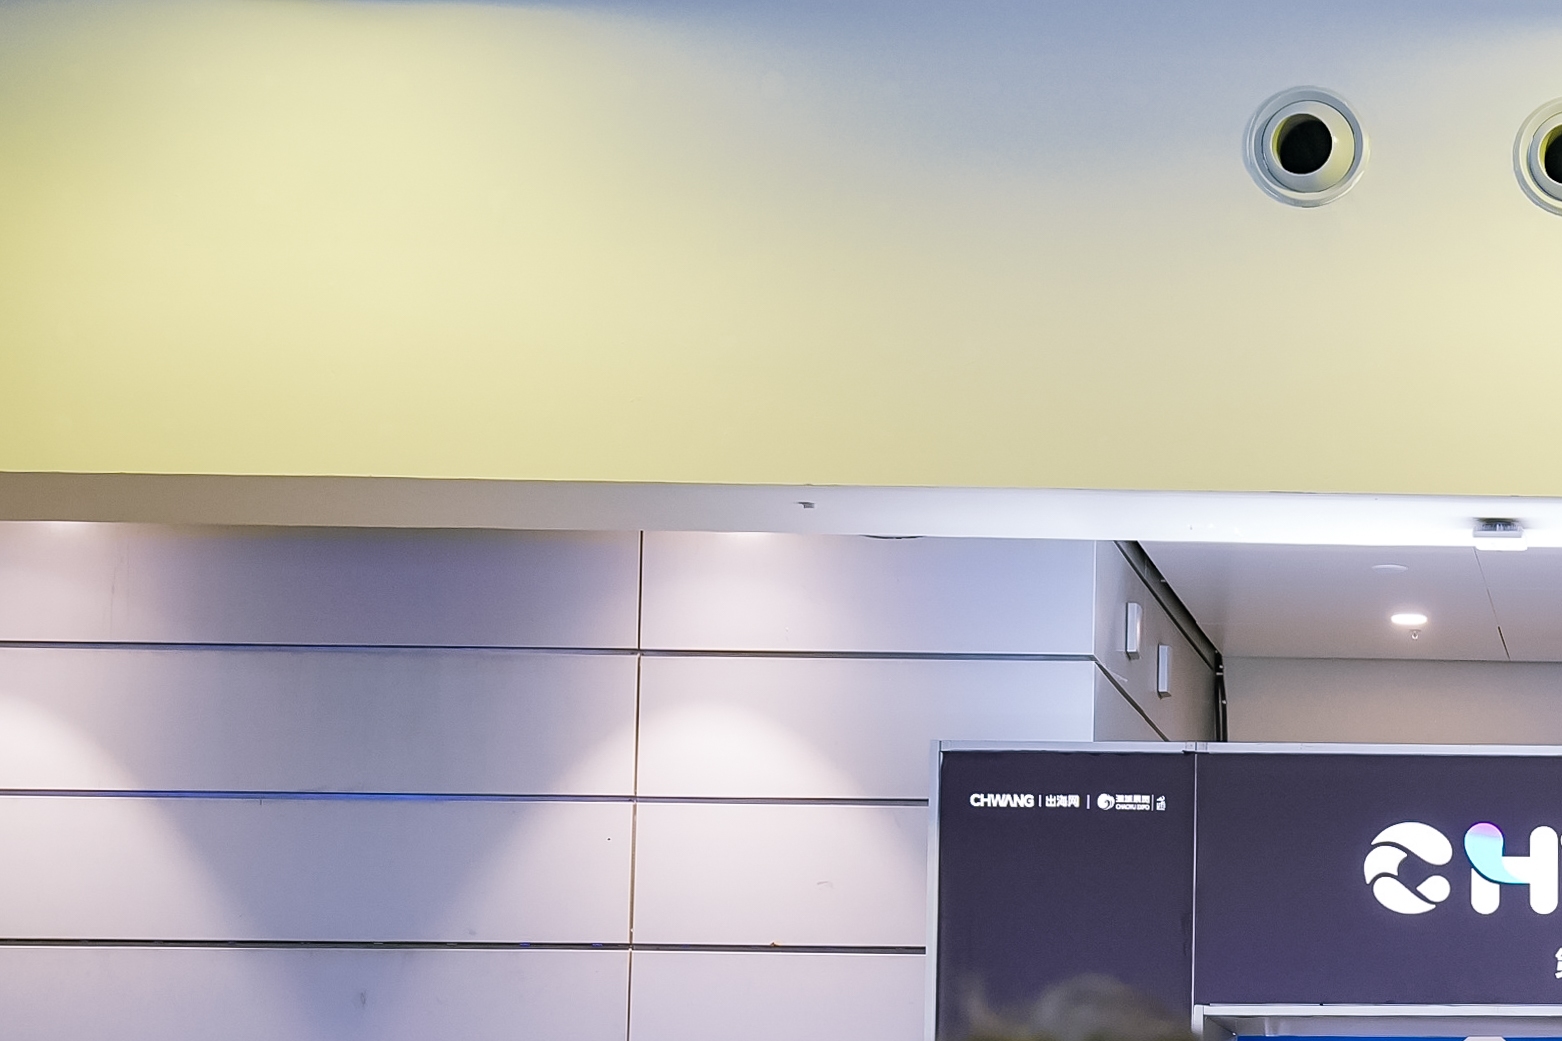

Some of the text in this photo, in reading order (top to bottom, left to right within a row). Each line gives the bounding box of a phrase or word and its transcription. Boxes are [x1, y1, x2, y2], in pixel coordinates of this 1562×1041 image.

[969, 793, 1080, 807] CHWANG 出海网
